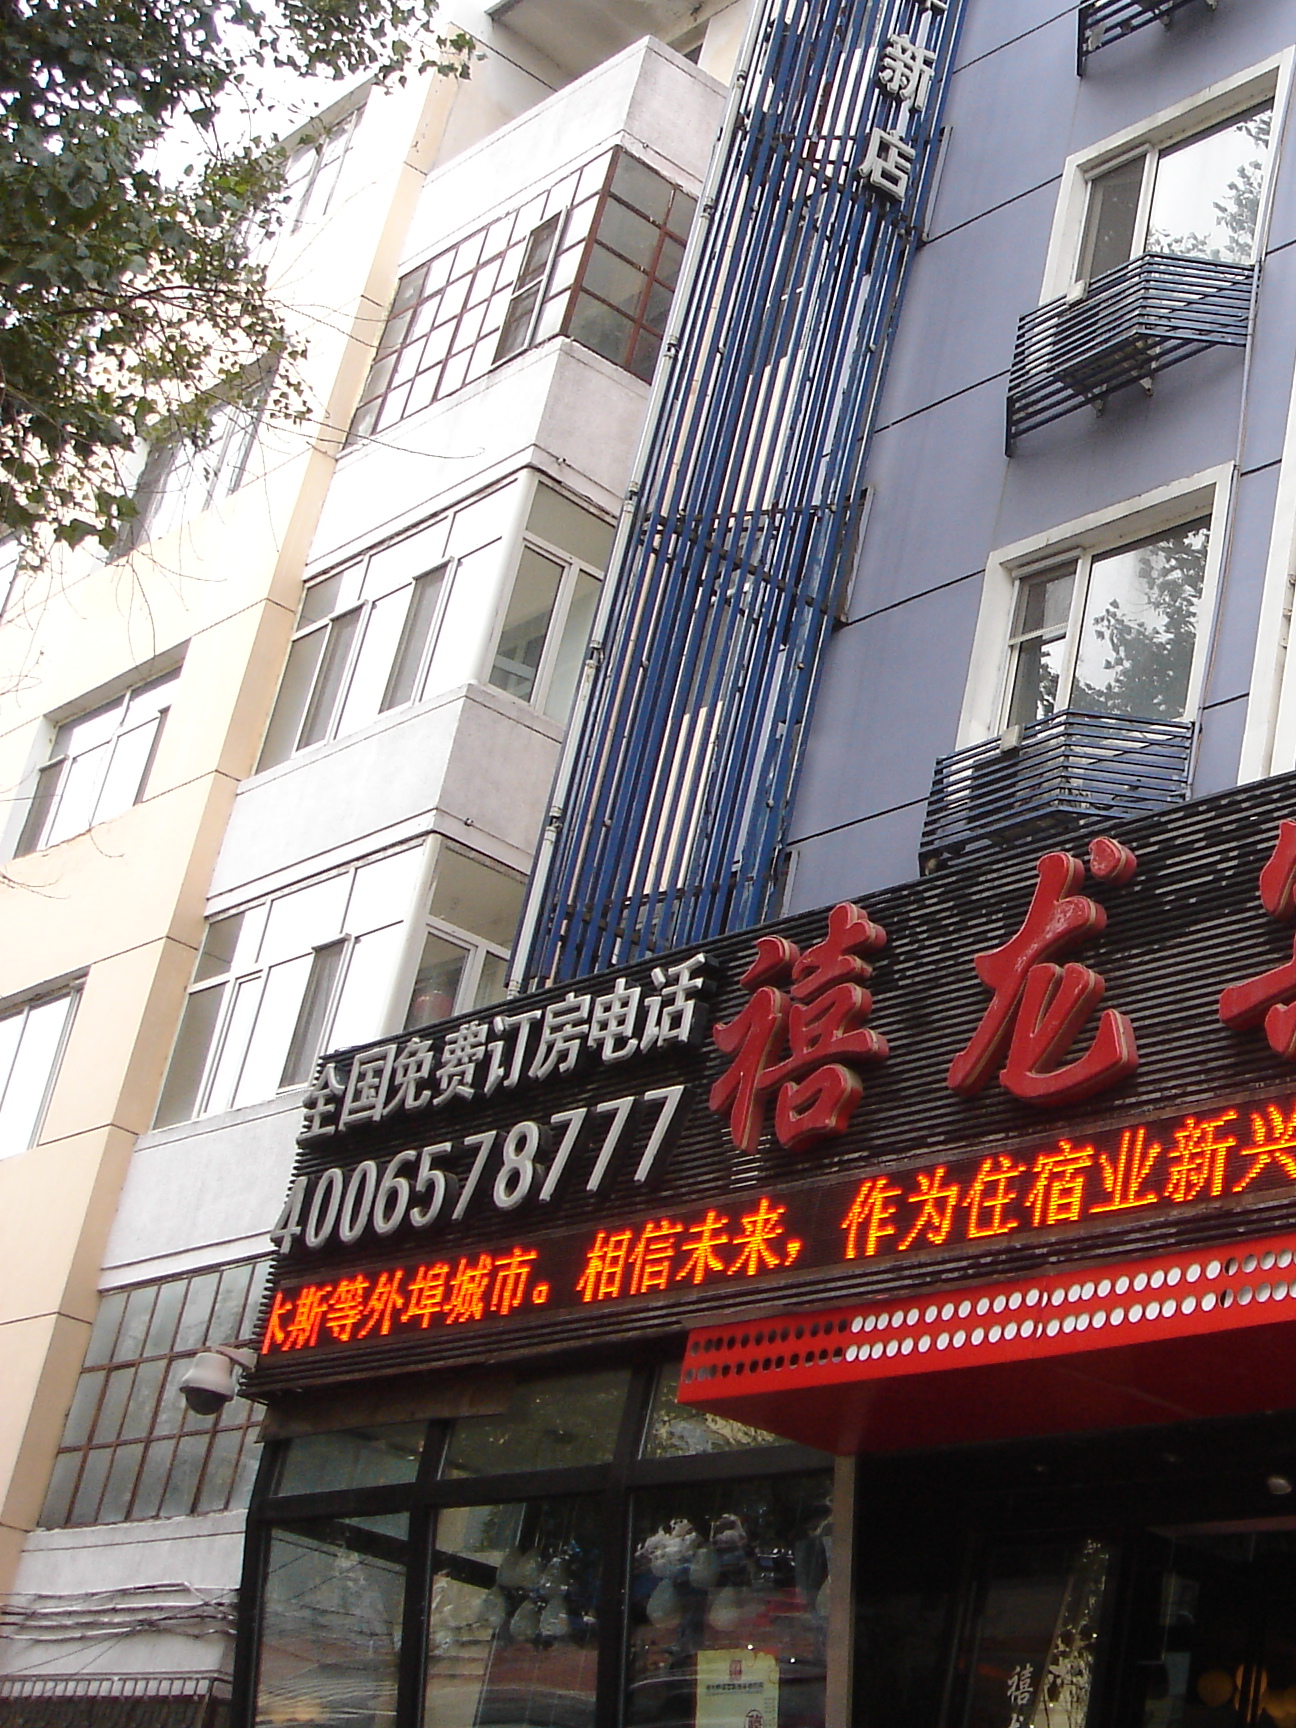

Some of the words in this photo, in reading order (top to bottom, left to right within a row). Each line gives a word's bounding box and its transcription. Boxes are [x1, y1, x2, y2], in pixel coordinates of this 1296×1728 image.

[858, 0, 947, 202] 新店
[299, 952, 707, 1142] 全国免费订房电话
[270, 1083, 686, 1255] 4006578777
